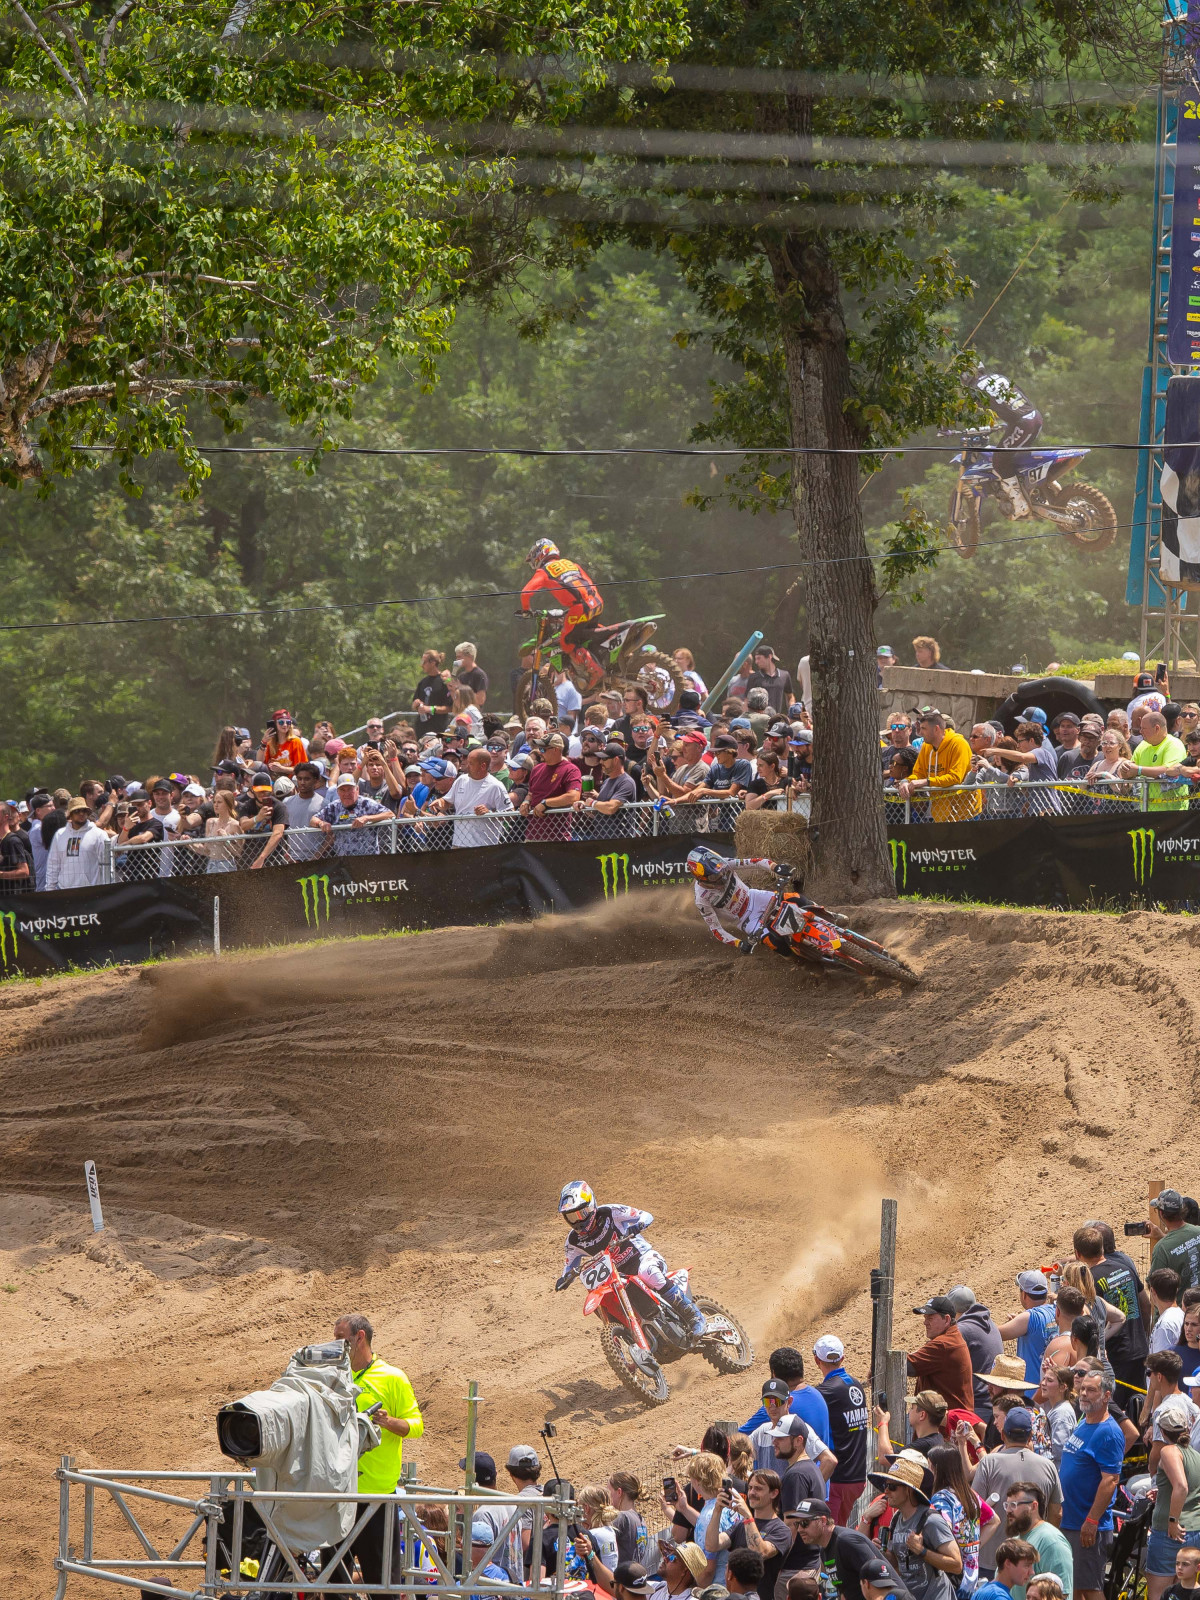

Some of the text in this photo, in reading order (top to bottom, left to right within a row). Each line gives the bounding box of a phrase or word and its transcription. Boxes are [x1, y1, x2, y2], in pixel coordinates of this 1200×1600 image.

[909, 848, 977, 864] MONSTER
[632, 861, 692, 877] MONSTE
[921, 864, 967, 873] ENERGY
[332, 878, 409, 897] MONSTER
[644, 877, 693, 887] ENERGY
[346, 895, 399, 905] ENERGY
[20, 912, 101, 933] MONSTER
[34, 929, 90, 941] ENERGY
[88, 1175, 98, 1199] UFO
[586, 1261, 610, 1288] 96
